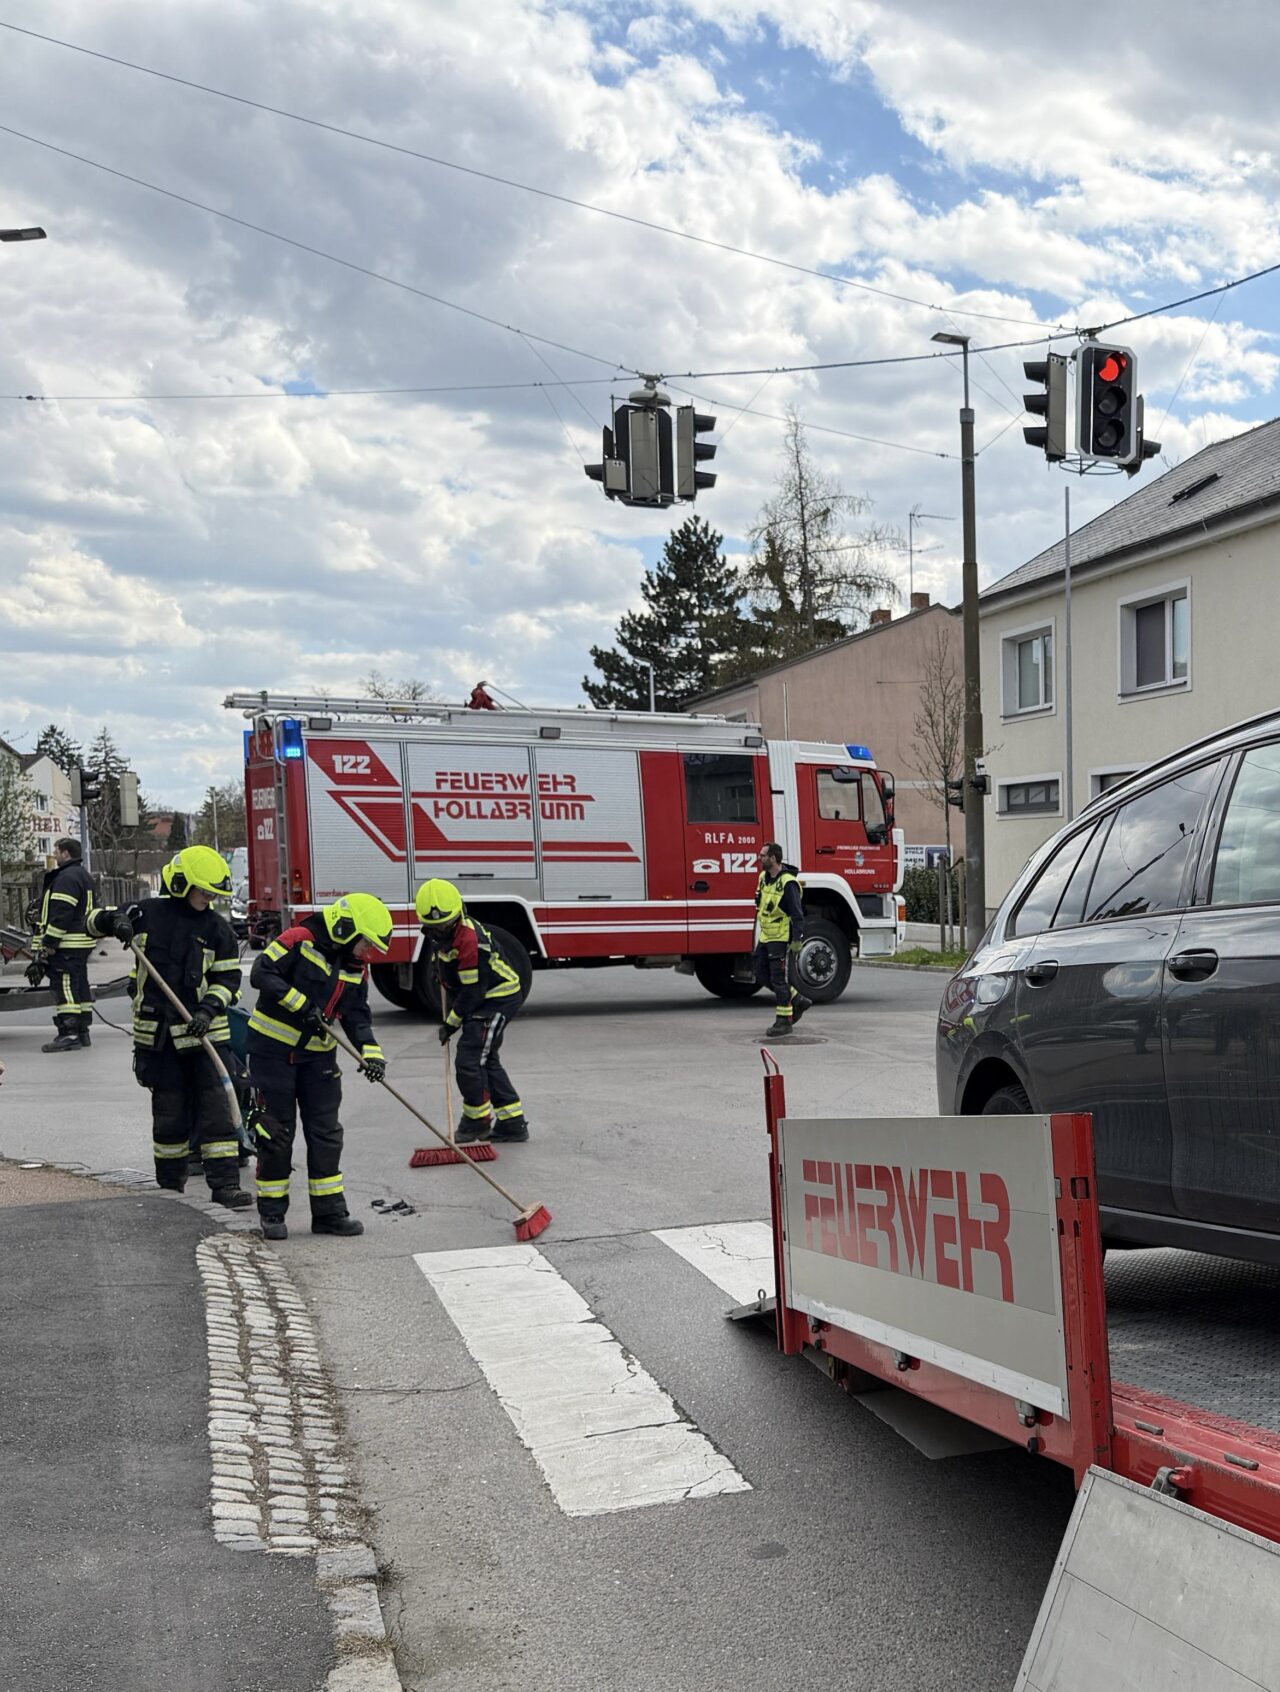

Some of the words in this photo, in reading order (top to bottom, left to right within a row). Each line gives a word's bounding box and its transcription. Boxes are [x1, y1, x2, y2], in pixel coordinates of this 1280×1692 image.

[332, 755, 371, 774] 122
[435, 772, 576, 793] FEUERWEHR
[434, 801, 585, 821] HOLLABRUNN
[704, 832, 735, 844] RLFA
[738, 836, 756, 844] 2000
[721, 853, 758, 873] 122
[802, 1159, 1015, 1304] FEUERWEHR
